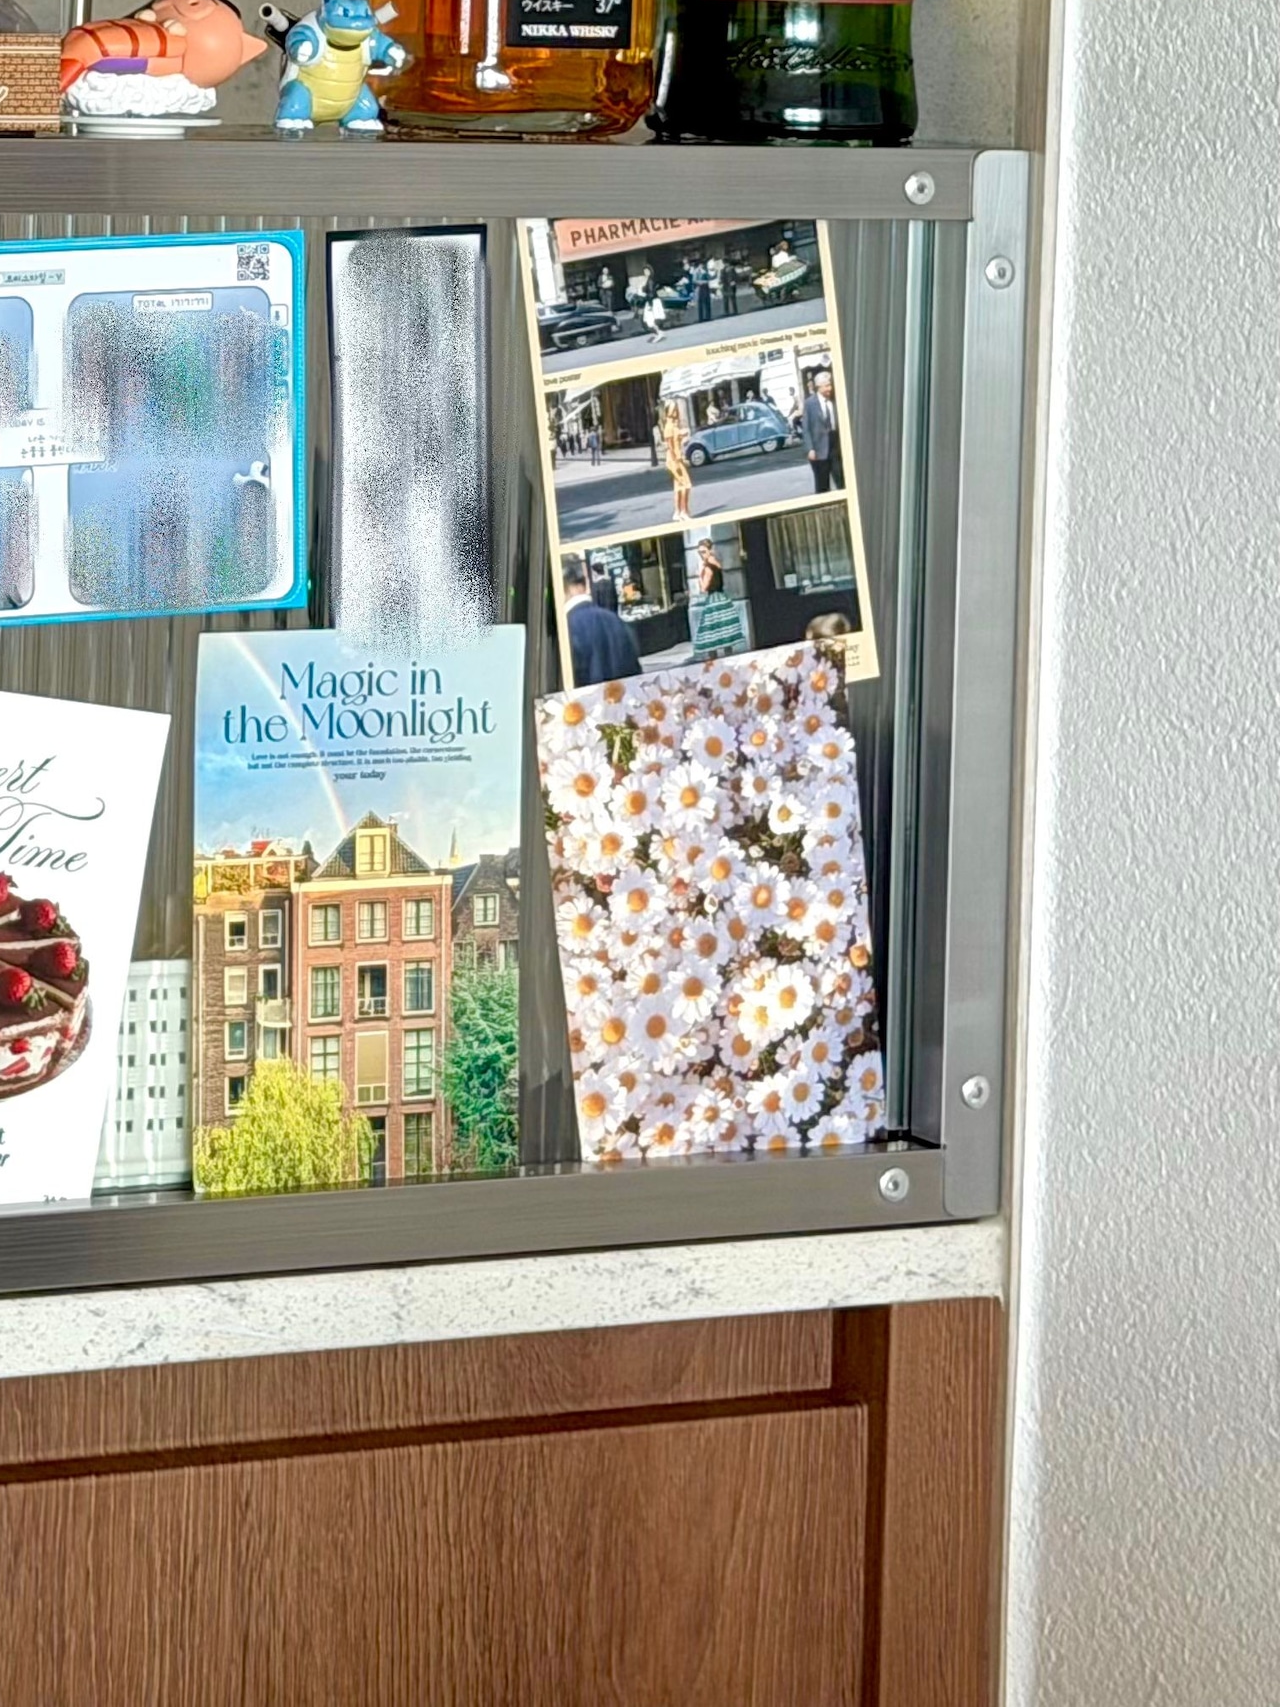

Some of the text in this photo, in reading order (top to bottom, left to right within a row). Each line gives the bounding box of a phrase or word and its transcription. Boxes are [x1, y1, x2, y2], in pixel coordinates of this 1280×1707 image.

[521, 24, 619, 38] NIKKA WHISKY
[570, 218, 680, 247] PHARMACIE
[280, 660, 443, 706] Magic in
[222, 696, 497, 744] the Moonlight
[333, 769, 387, 783] your today
